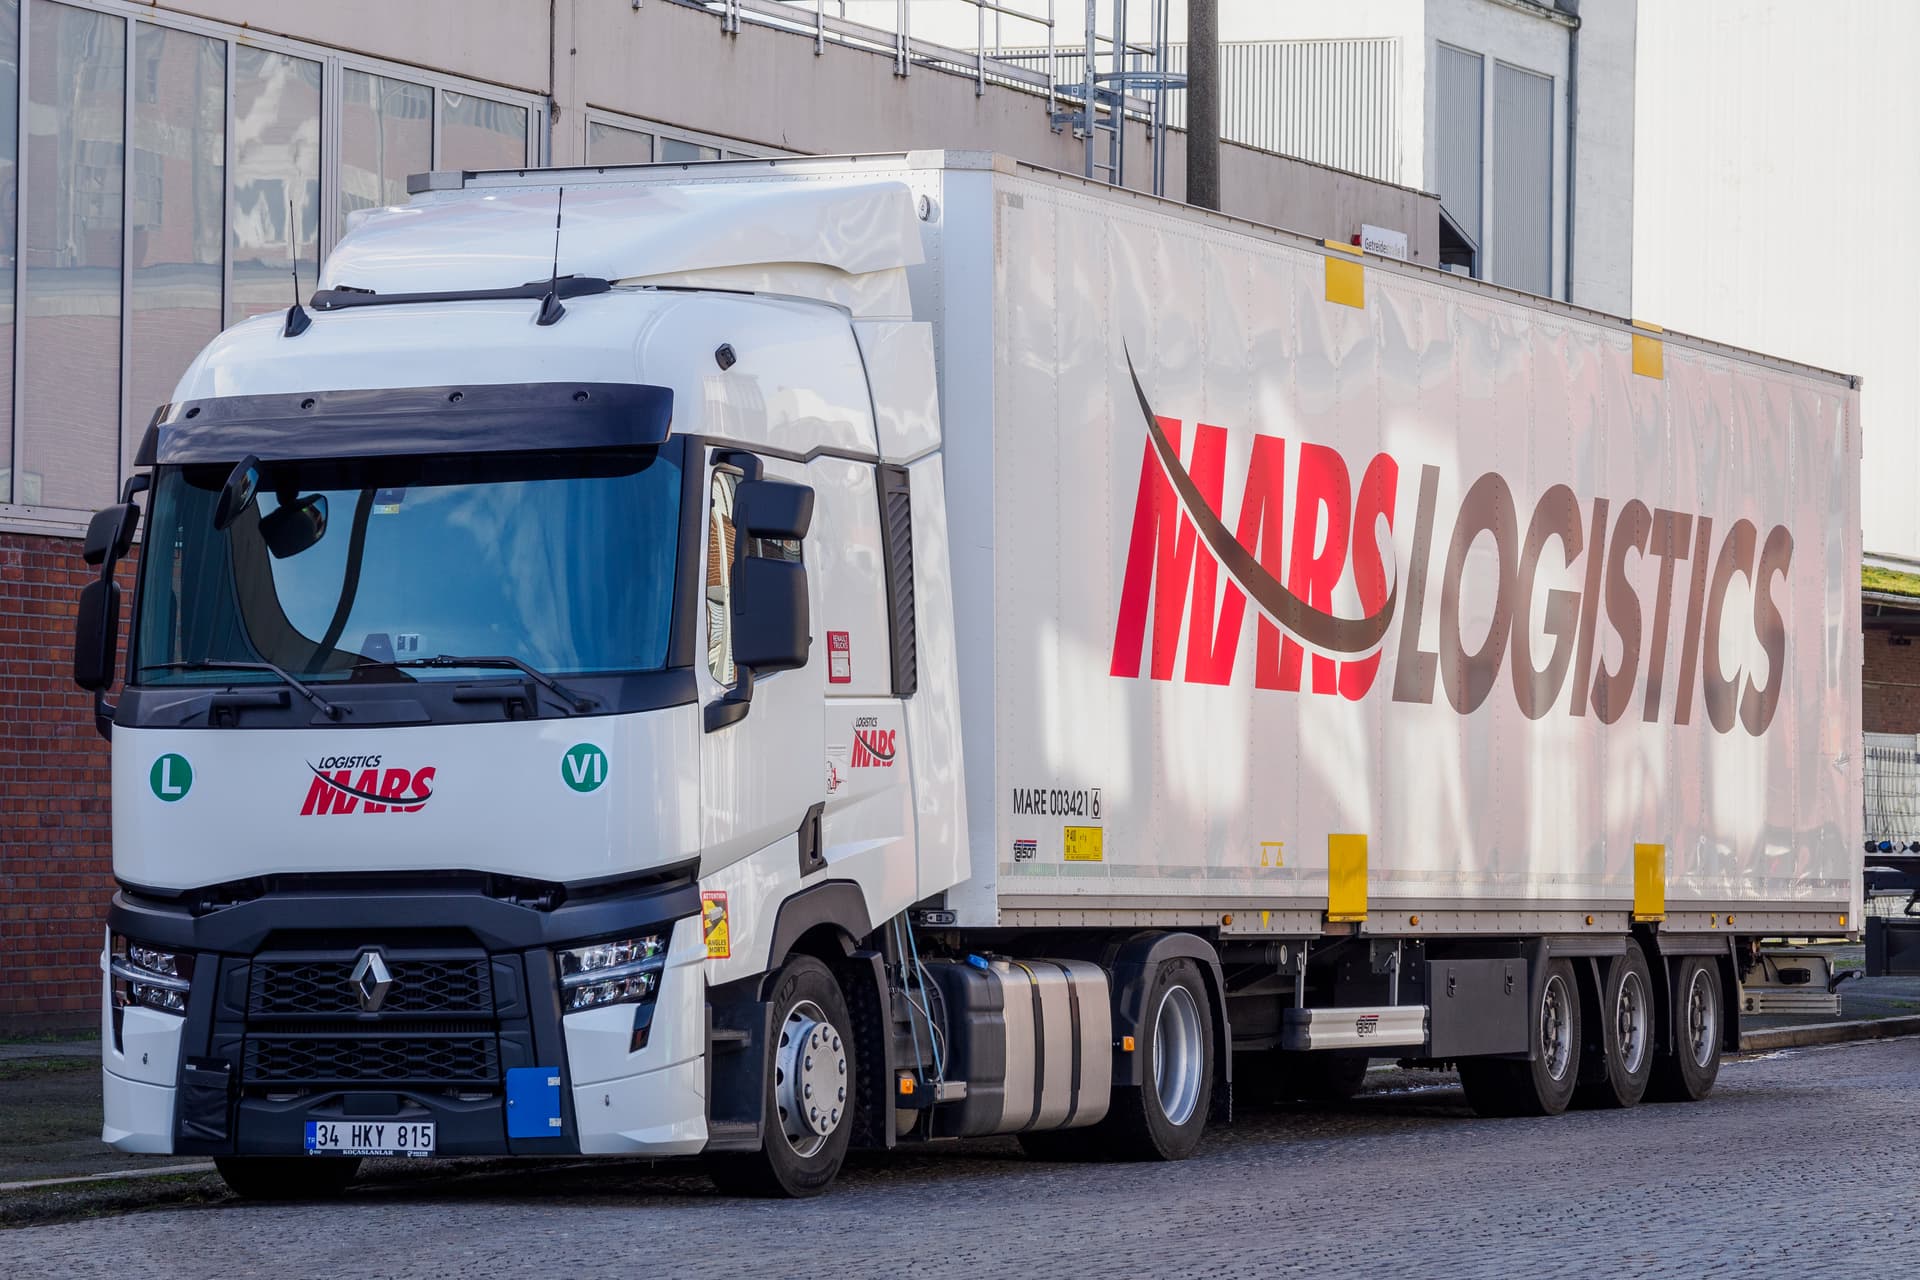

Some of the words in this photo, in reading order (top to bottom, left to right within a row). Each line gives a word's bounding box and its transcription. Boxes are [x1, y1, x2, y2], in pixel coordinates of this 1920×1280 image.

[1110, 415, 1399, 701] MARS
[1392, 464, 1793, 737] LOGISTICS
[832, 634, 848, 642] RENAULT
[833, 641, 849, 650] TRUCKS
[855, 716, 878, 728] LOGISTICS
[318, 755, 382, 769] LOGISTICS
[851, 729, 896, 769] MARS
[162, 758, 182, 794] L
[567, 753, 601, 784] VI
[300, 766, 436, 816] MARS
[1013, 788, 1047, 815] MARE
[1050, 789, 1088, 816] 003421
[307, 1136, 316, 1144] TR
[318, 1124, 339, 1147] 34
[352, 1125, 385, 1147] HKY
[397, 1126, 431, 1148] 815
